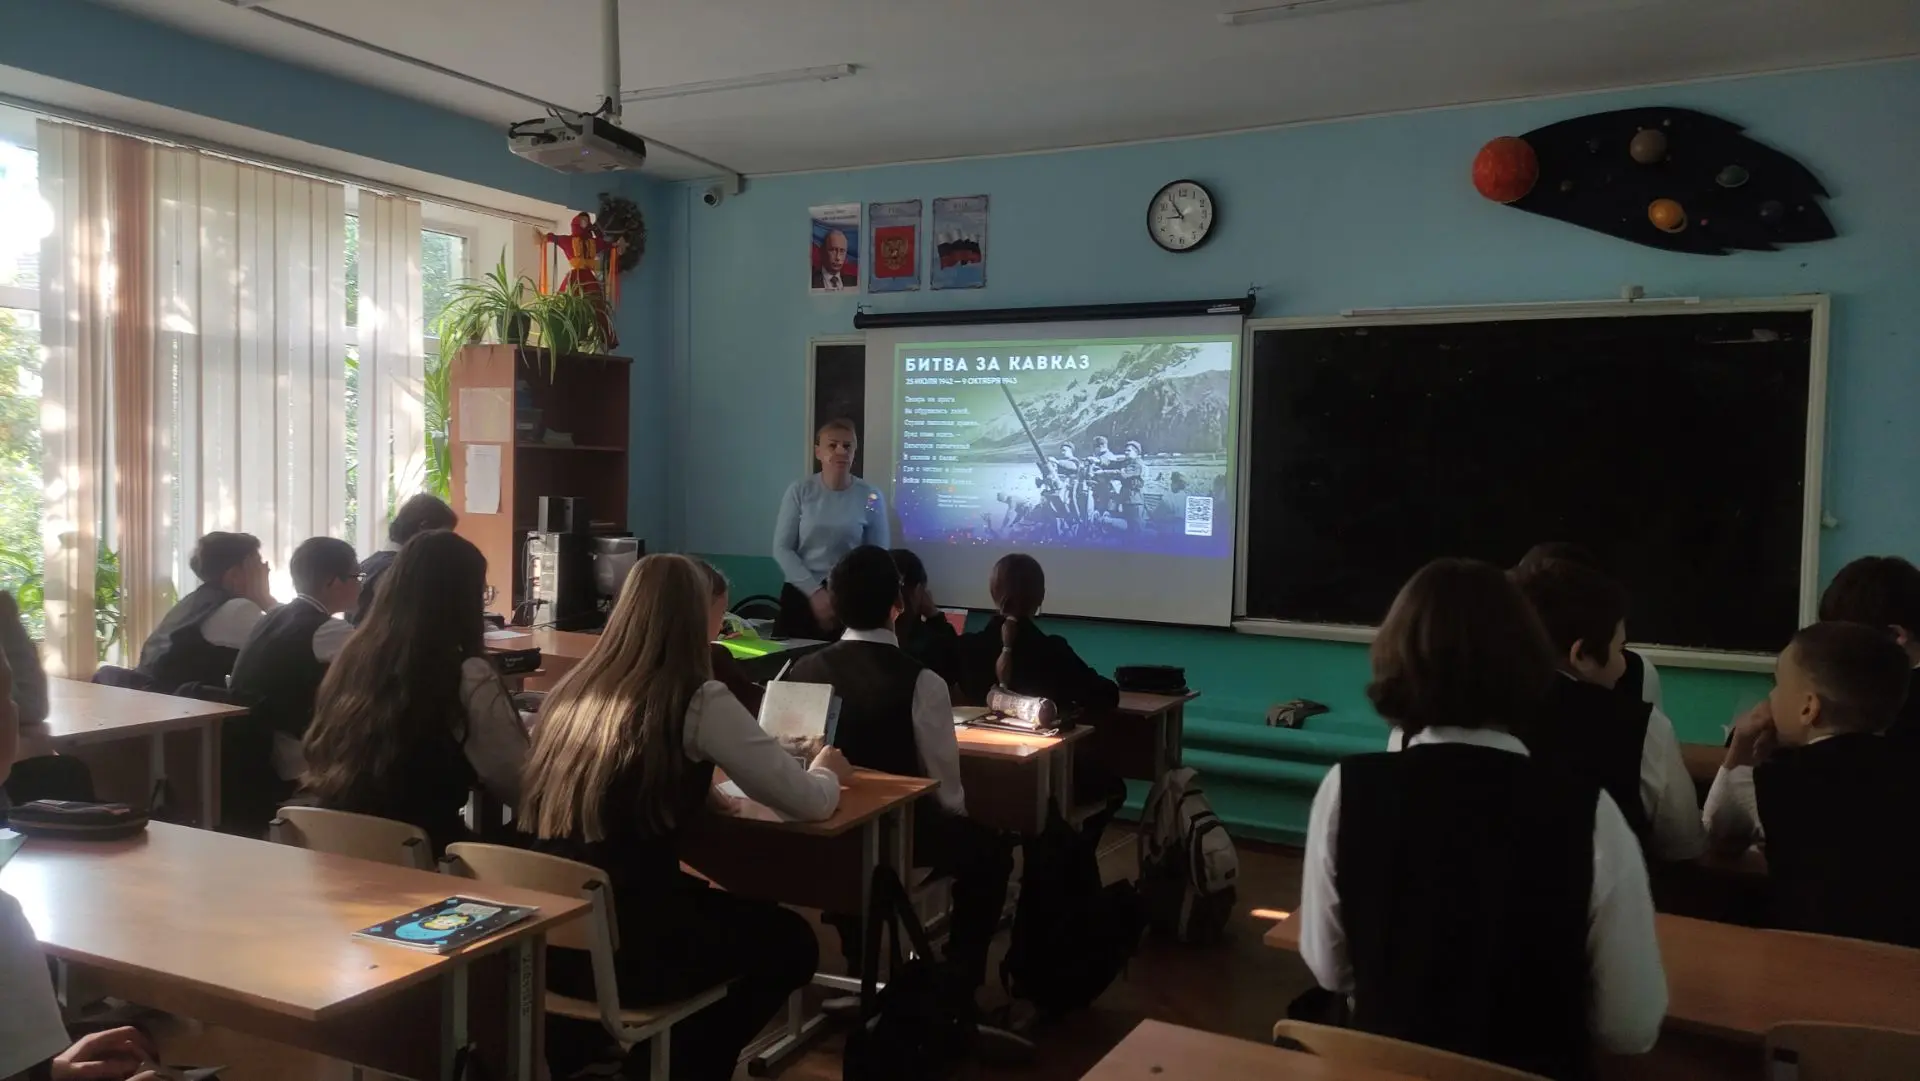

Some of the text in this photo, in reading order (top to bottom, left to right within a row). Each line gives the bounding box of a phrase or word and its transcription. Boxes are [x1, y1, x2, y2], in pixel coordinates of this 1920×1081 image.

[905, 355, 1090, 371] БИТВА ЗА КАВКАЗ
